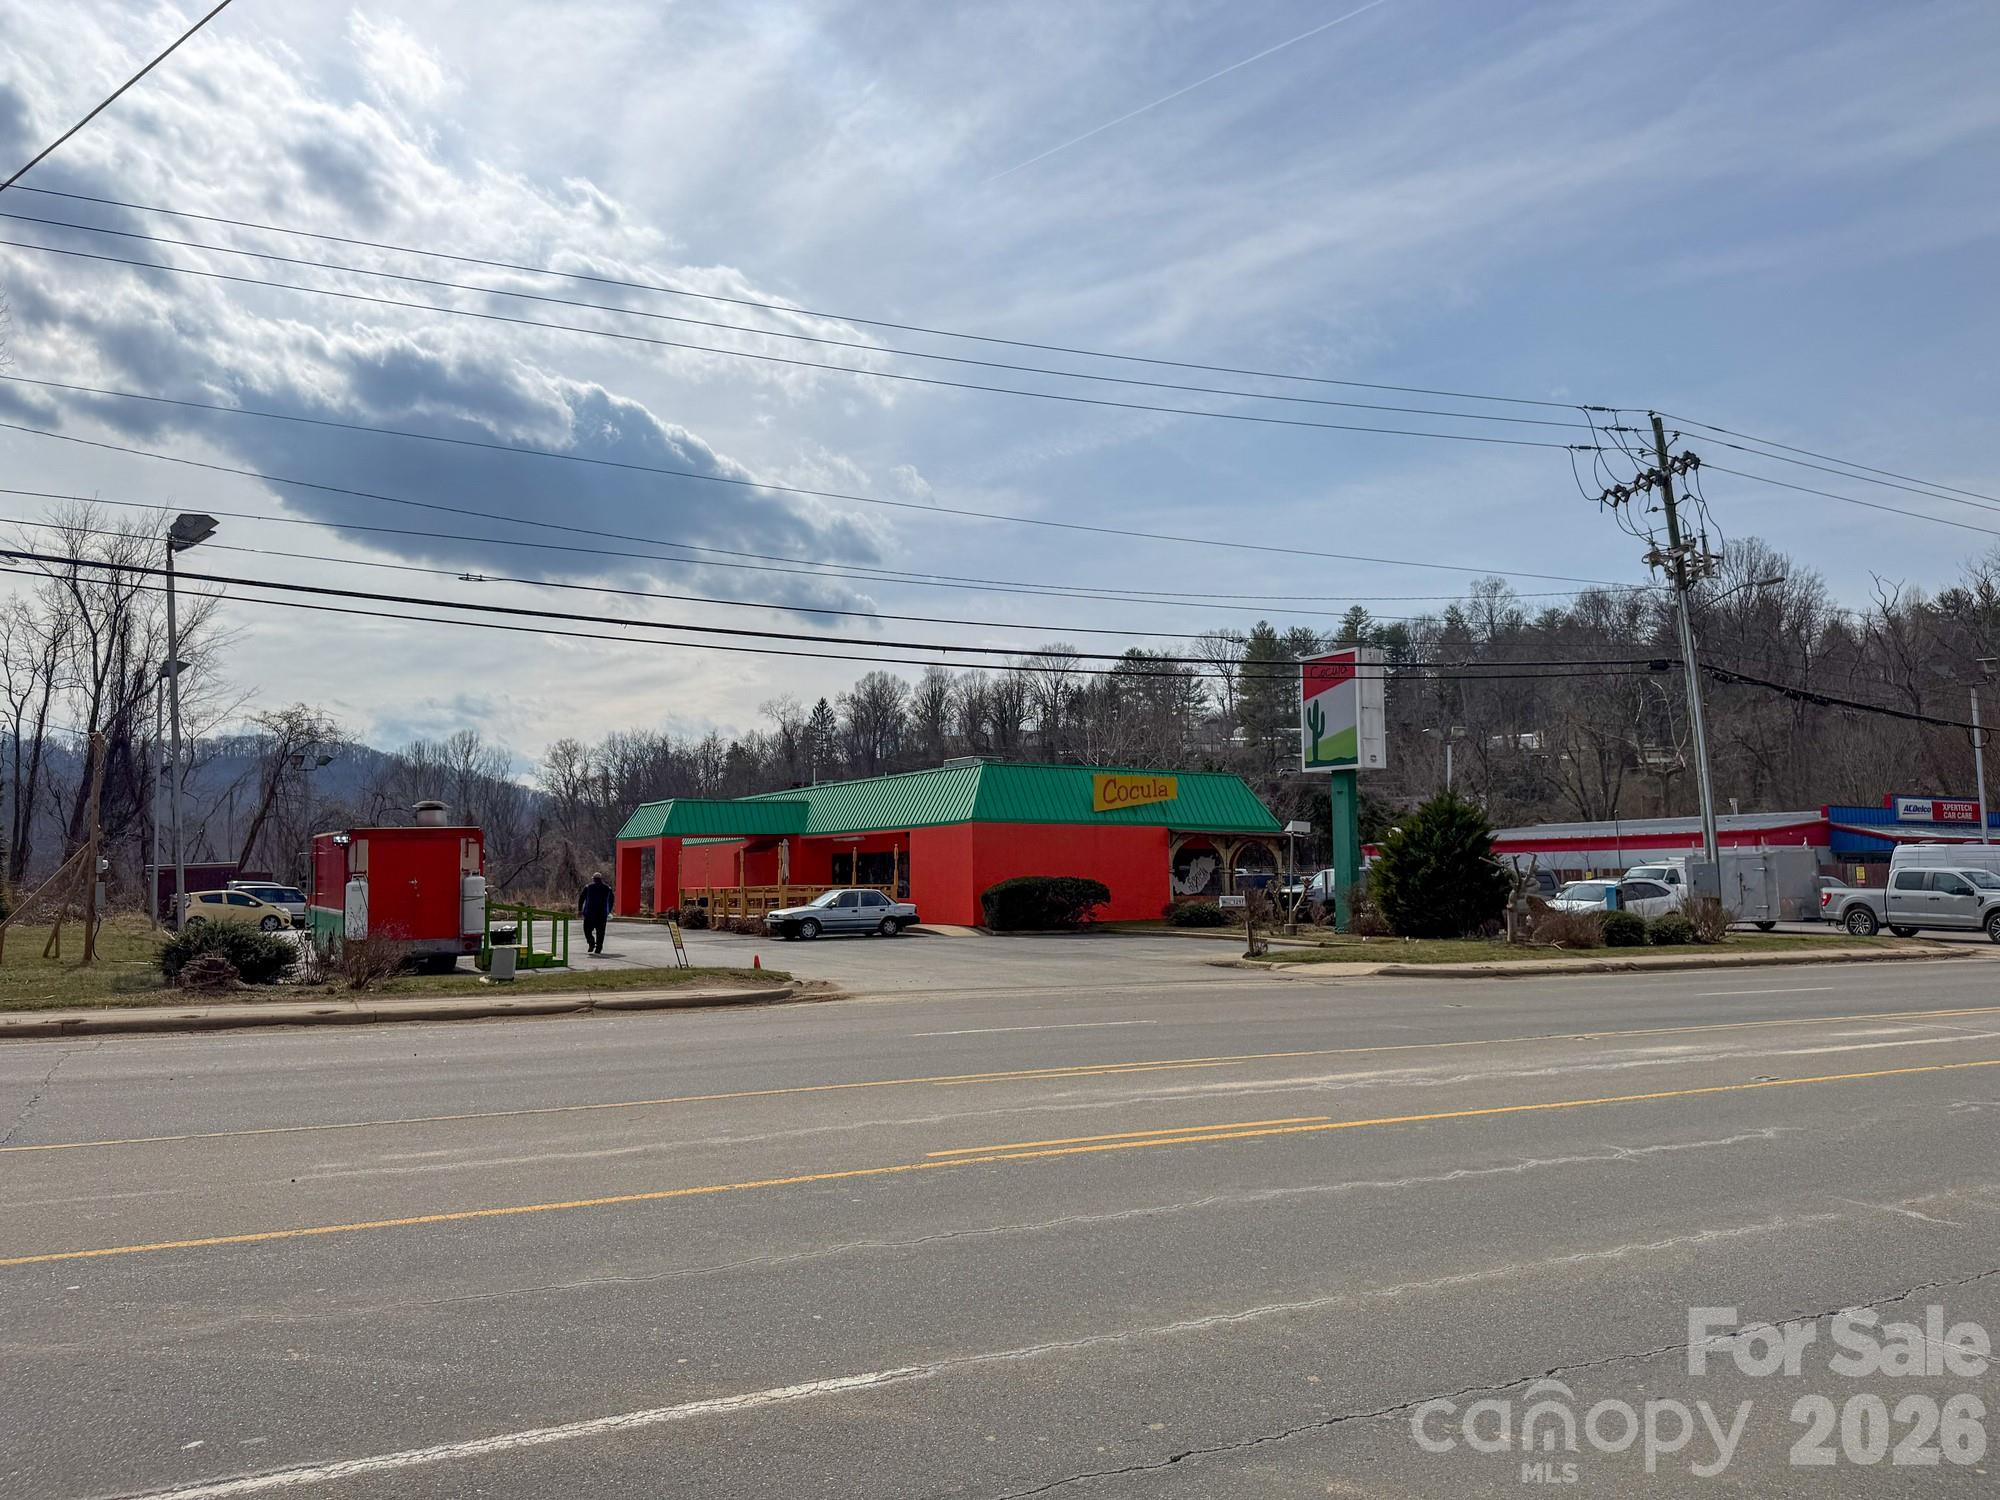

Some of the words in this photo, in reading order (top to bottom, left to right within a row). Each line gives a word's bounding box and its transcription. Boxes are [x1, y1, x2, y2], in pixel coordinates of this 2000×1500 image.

[1103, 778, 1168, 804] Cocula
[1903, 804, 1931, 812] ACDelco
[1942, 803, 1973, 812] XPERTECH
[1943, 811, 1956, 819] CAR
[1957, 812, 1973, 820] CARE
